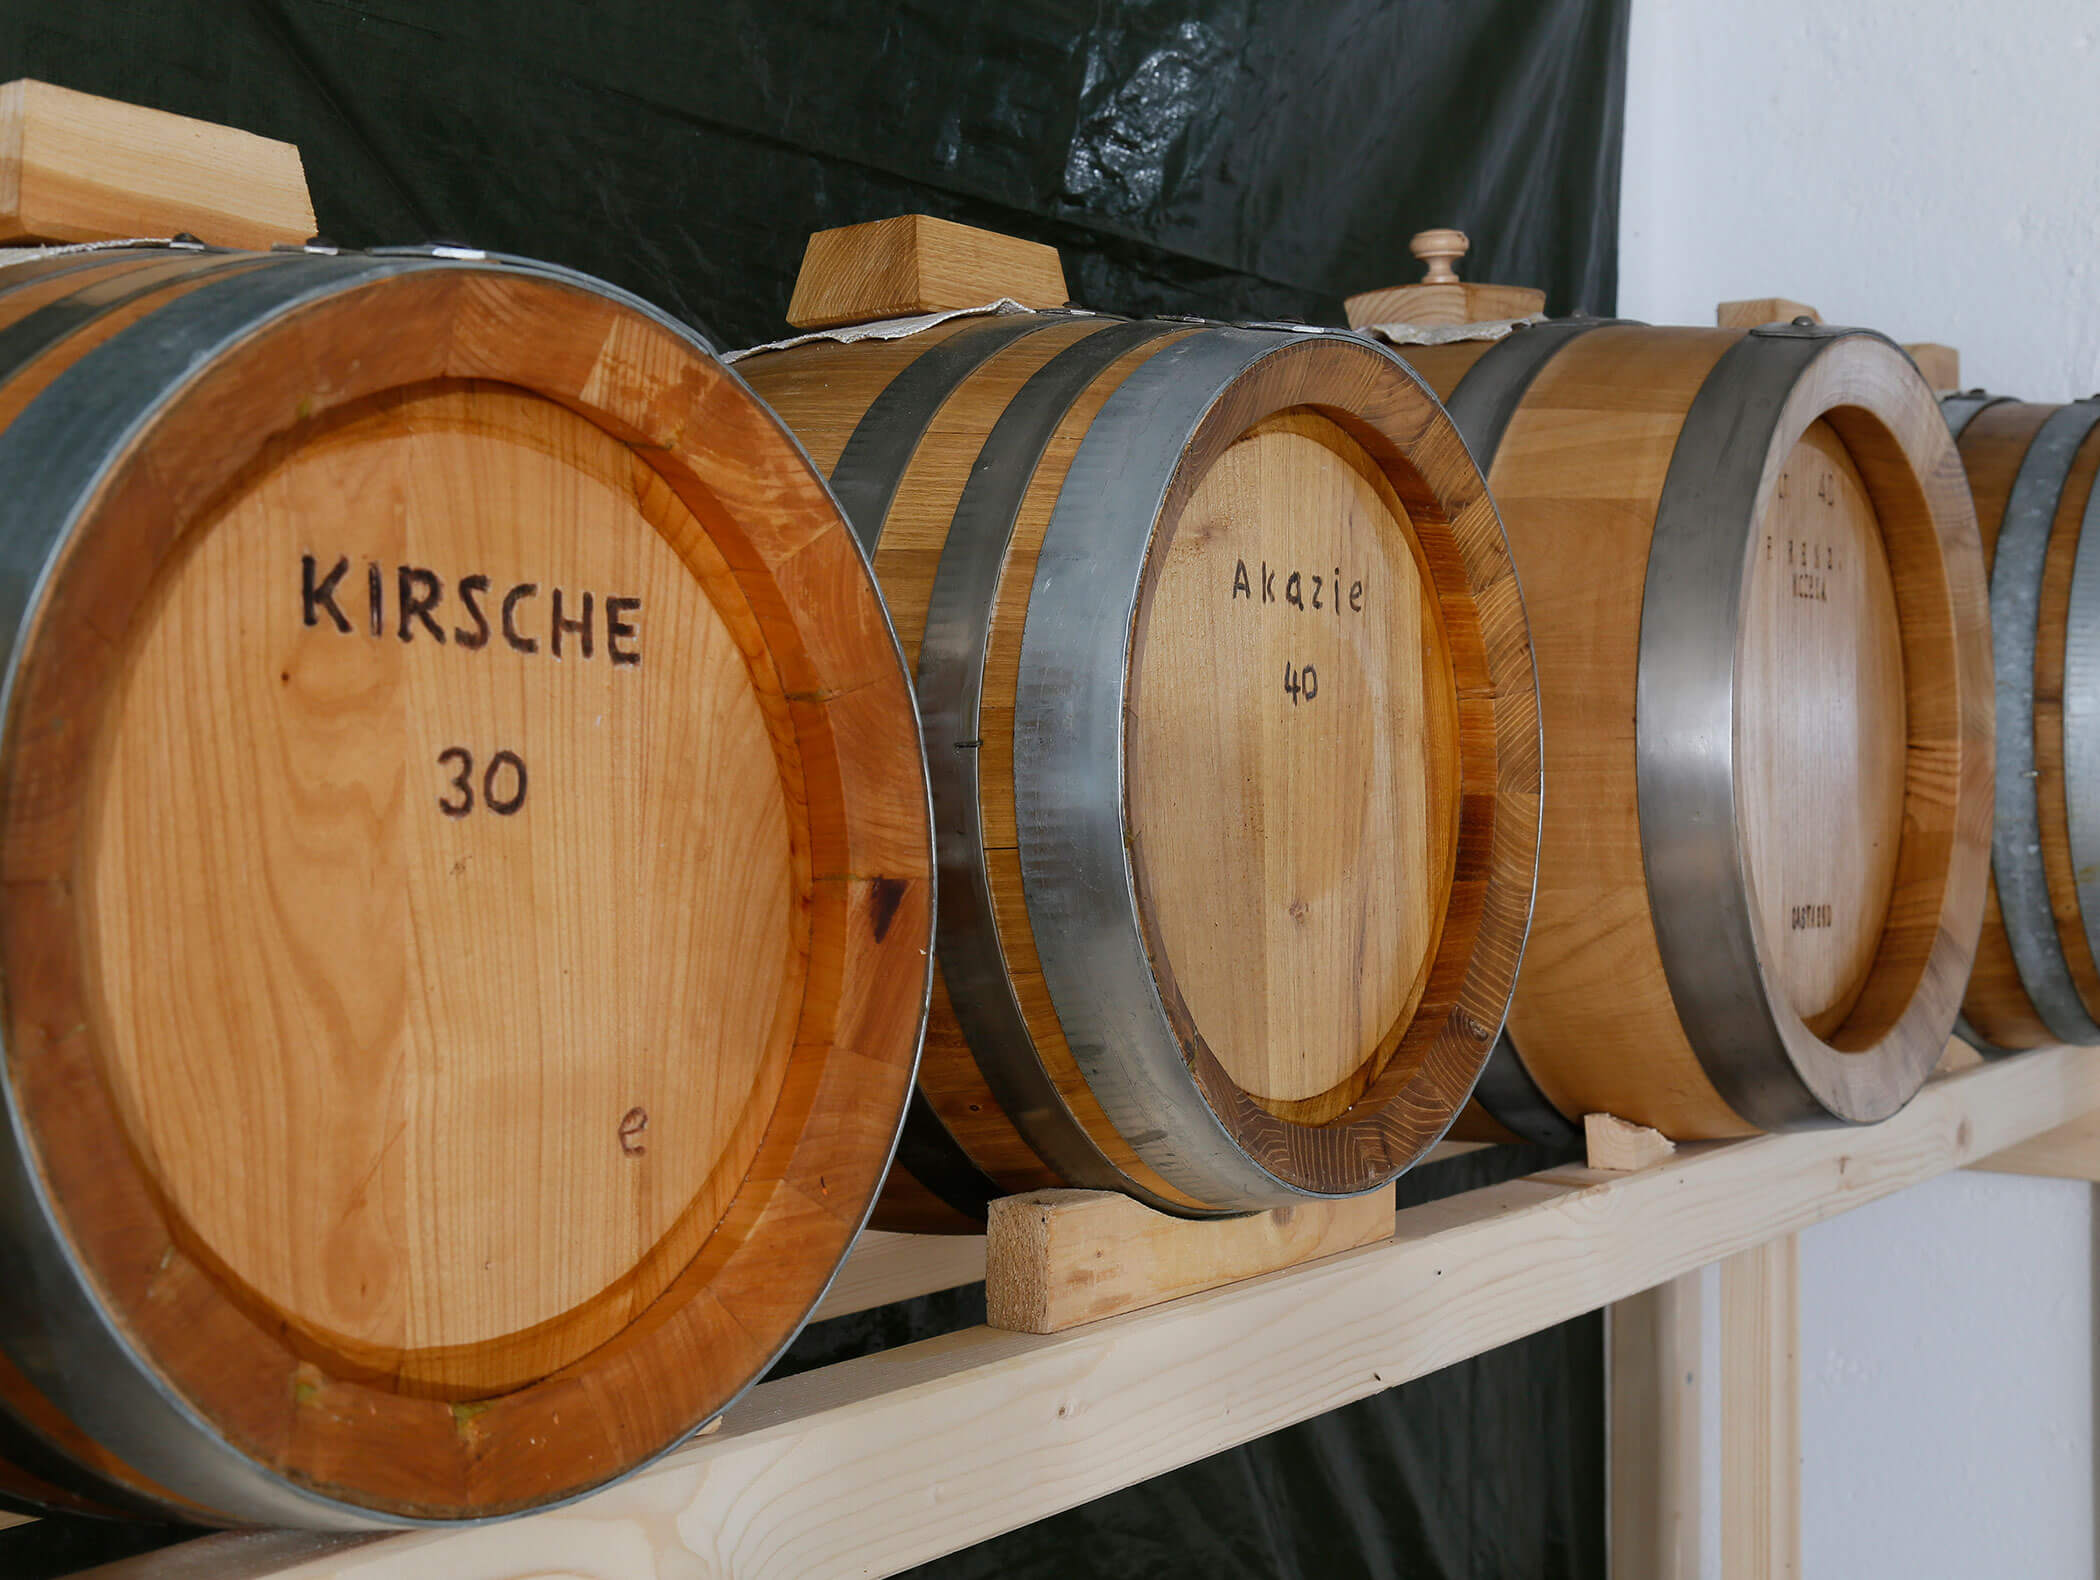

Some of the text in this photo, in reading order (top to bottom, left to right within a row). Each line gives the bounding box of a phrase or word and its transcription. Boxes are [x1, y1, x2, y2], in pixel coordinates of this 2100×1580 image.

[301, 554, 642, 666] KIRSCHE
[1232, 558, 1363, 616] Akazie
[1284, 660, 1318, 707] 40
[436, 746, 528, 818] 30
